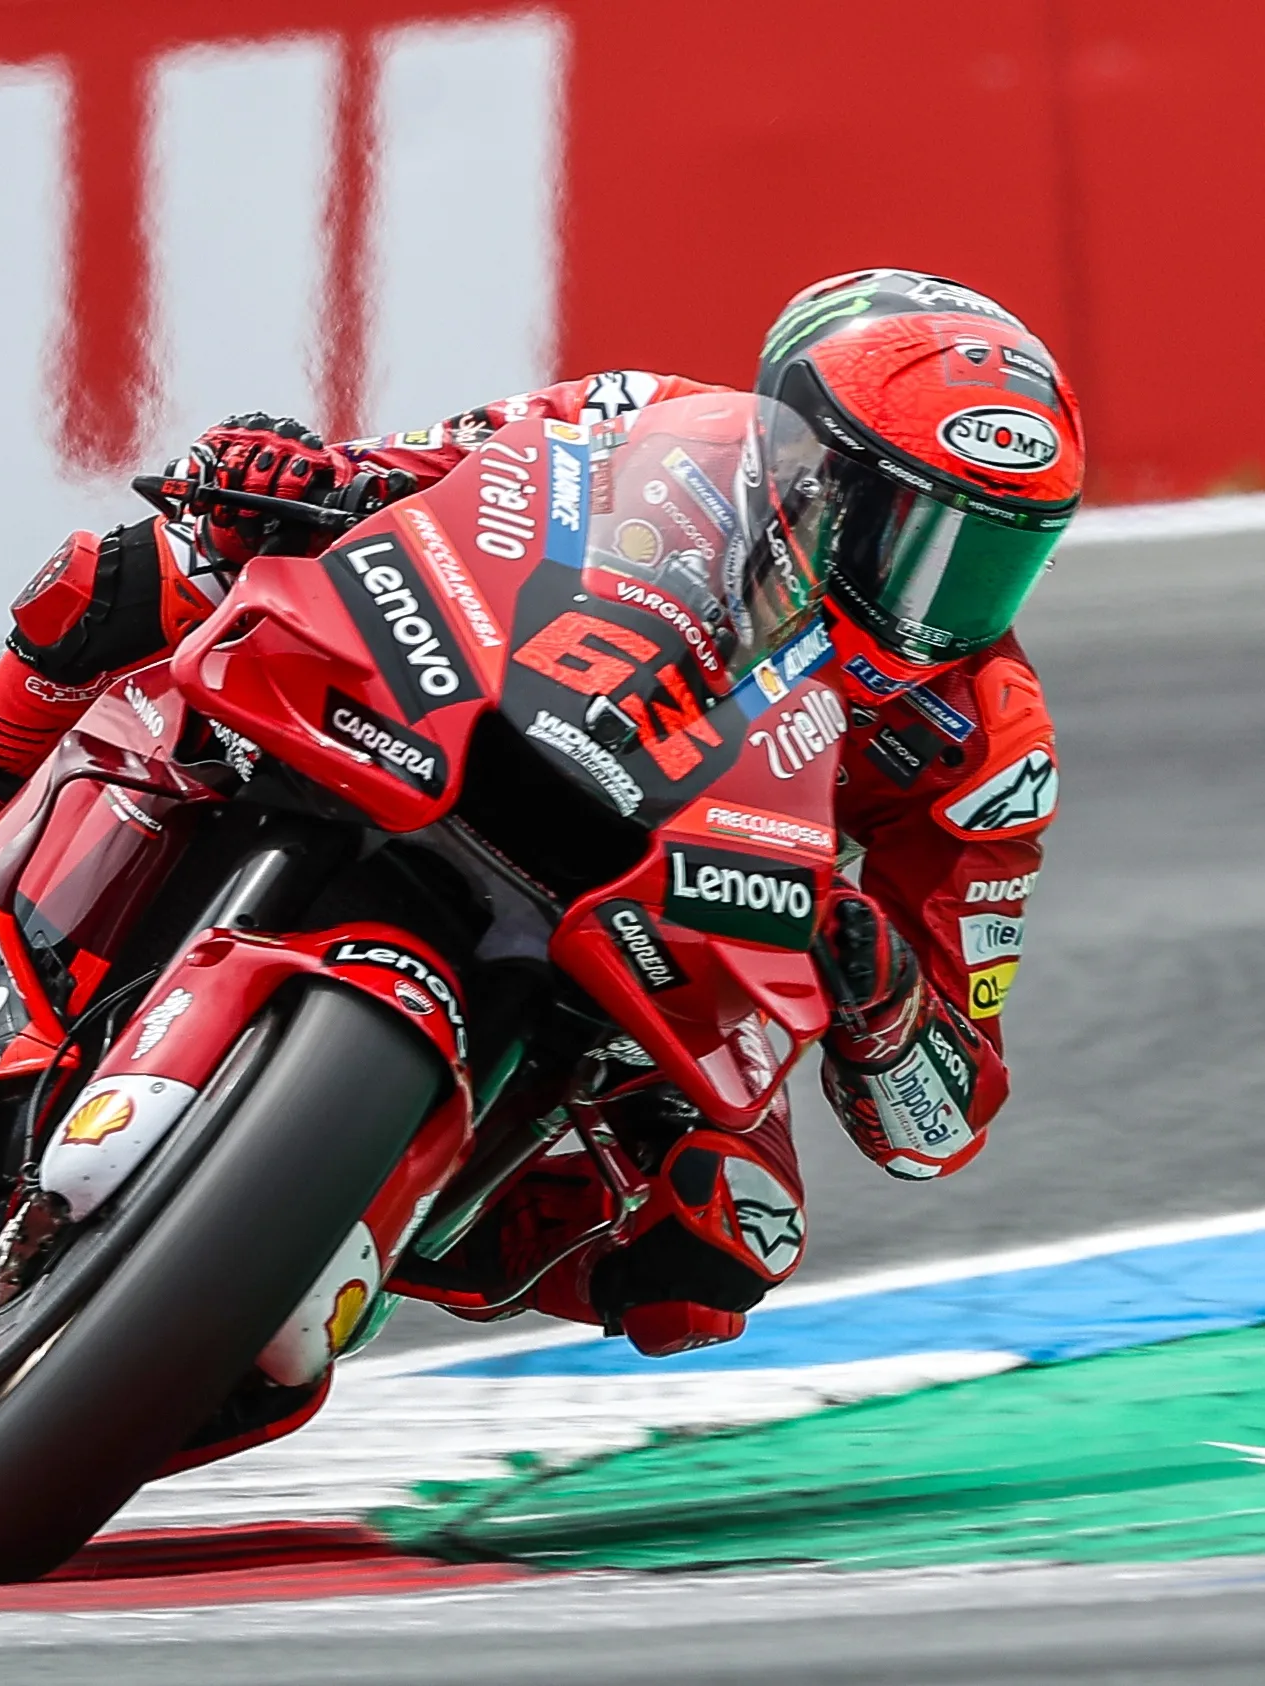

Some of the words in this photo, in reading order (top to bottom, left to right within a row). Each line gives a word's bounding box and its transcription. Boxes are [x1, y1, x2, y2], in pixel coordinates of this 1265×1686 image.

[345, 541, 460, 696] Lenovo
[616, 581, 719, 673] VARGROUP
[331, 707, 437, 783] CARRERA
[705, 806, 833, 850] FRECCIAROSSA
[671, 851, 812, 919] Lenovo
[611, 908, 675, 989] CARRERA
[890, 1050, 960, 1147] UnipolSai
